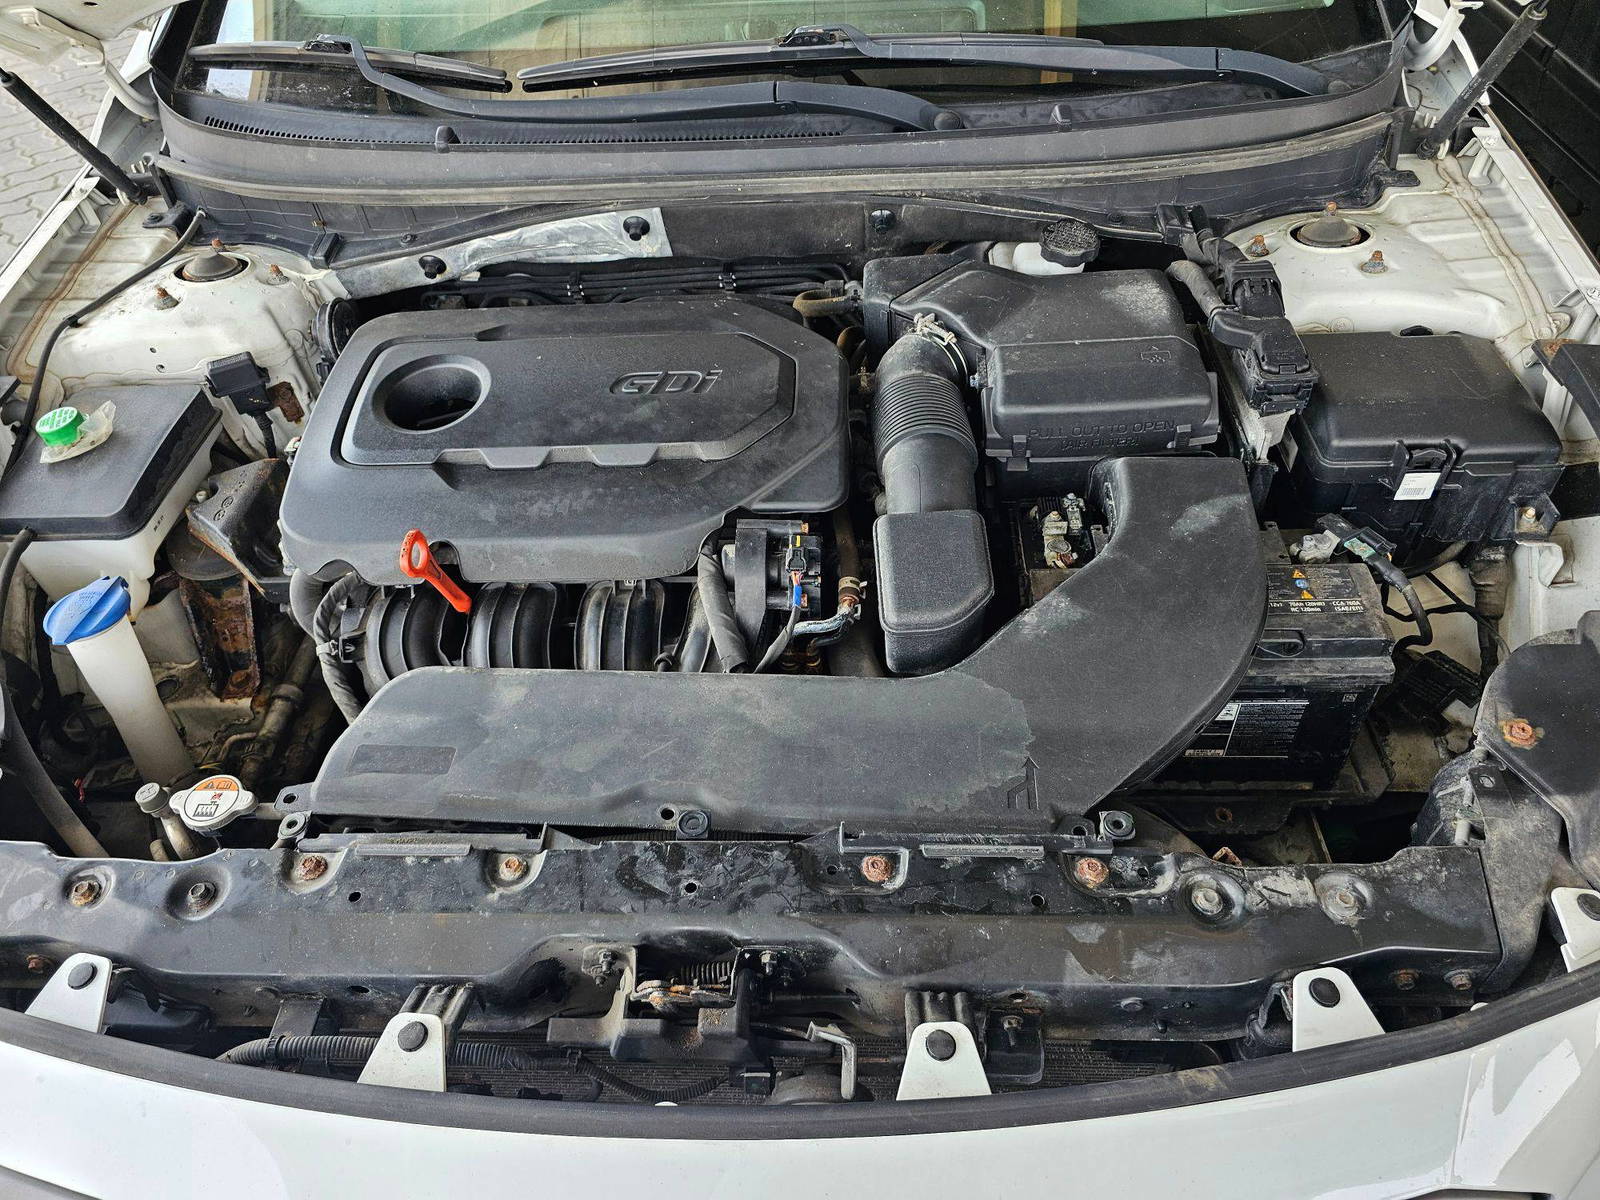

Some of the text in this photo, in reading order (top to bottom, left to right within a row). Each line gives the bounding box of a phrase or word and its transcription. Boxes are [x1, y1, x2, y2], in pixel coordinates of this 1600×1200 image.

[609, 369, 723, 395] GDi
[1028, 419, 1176, 440] PULL OUT TO OPEN
